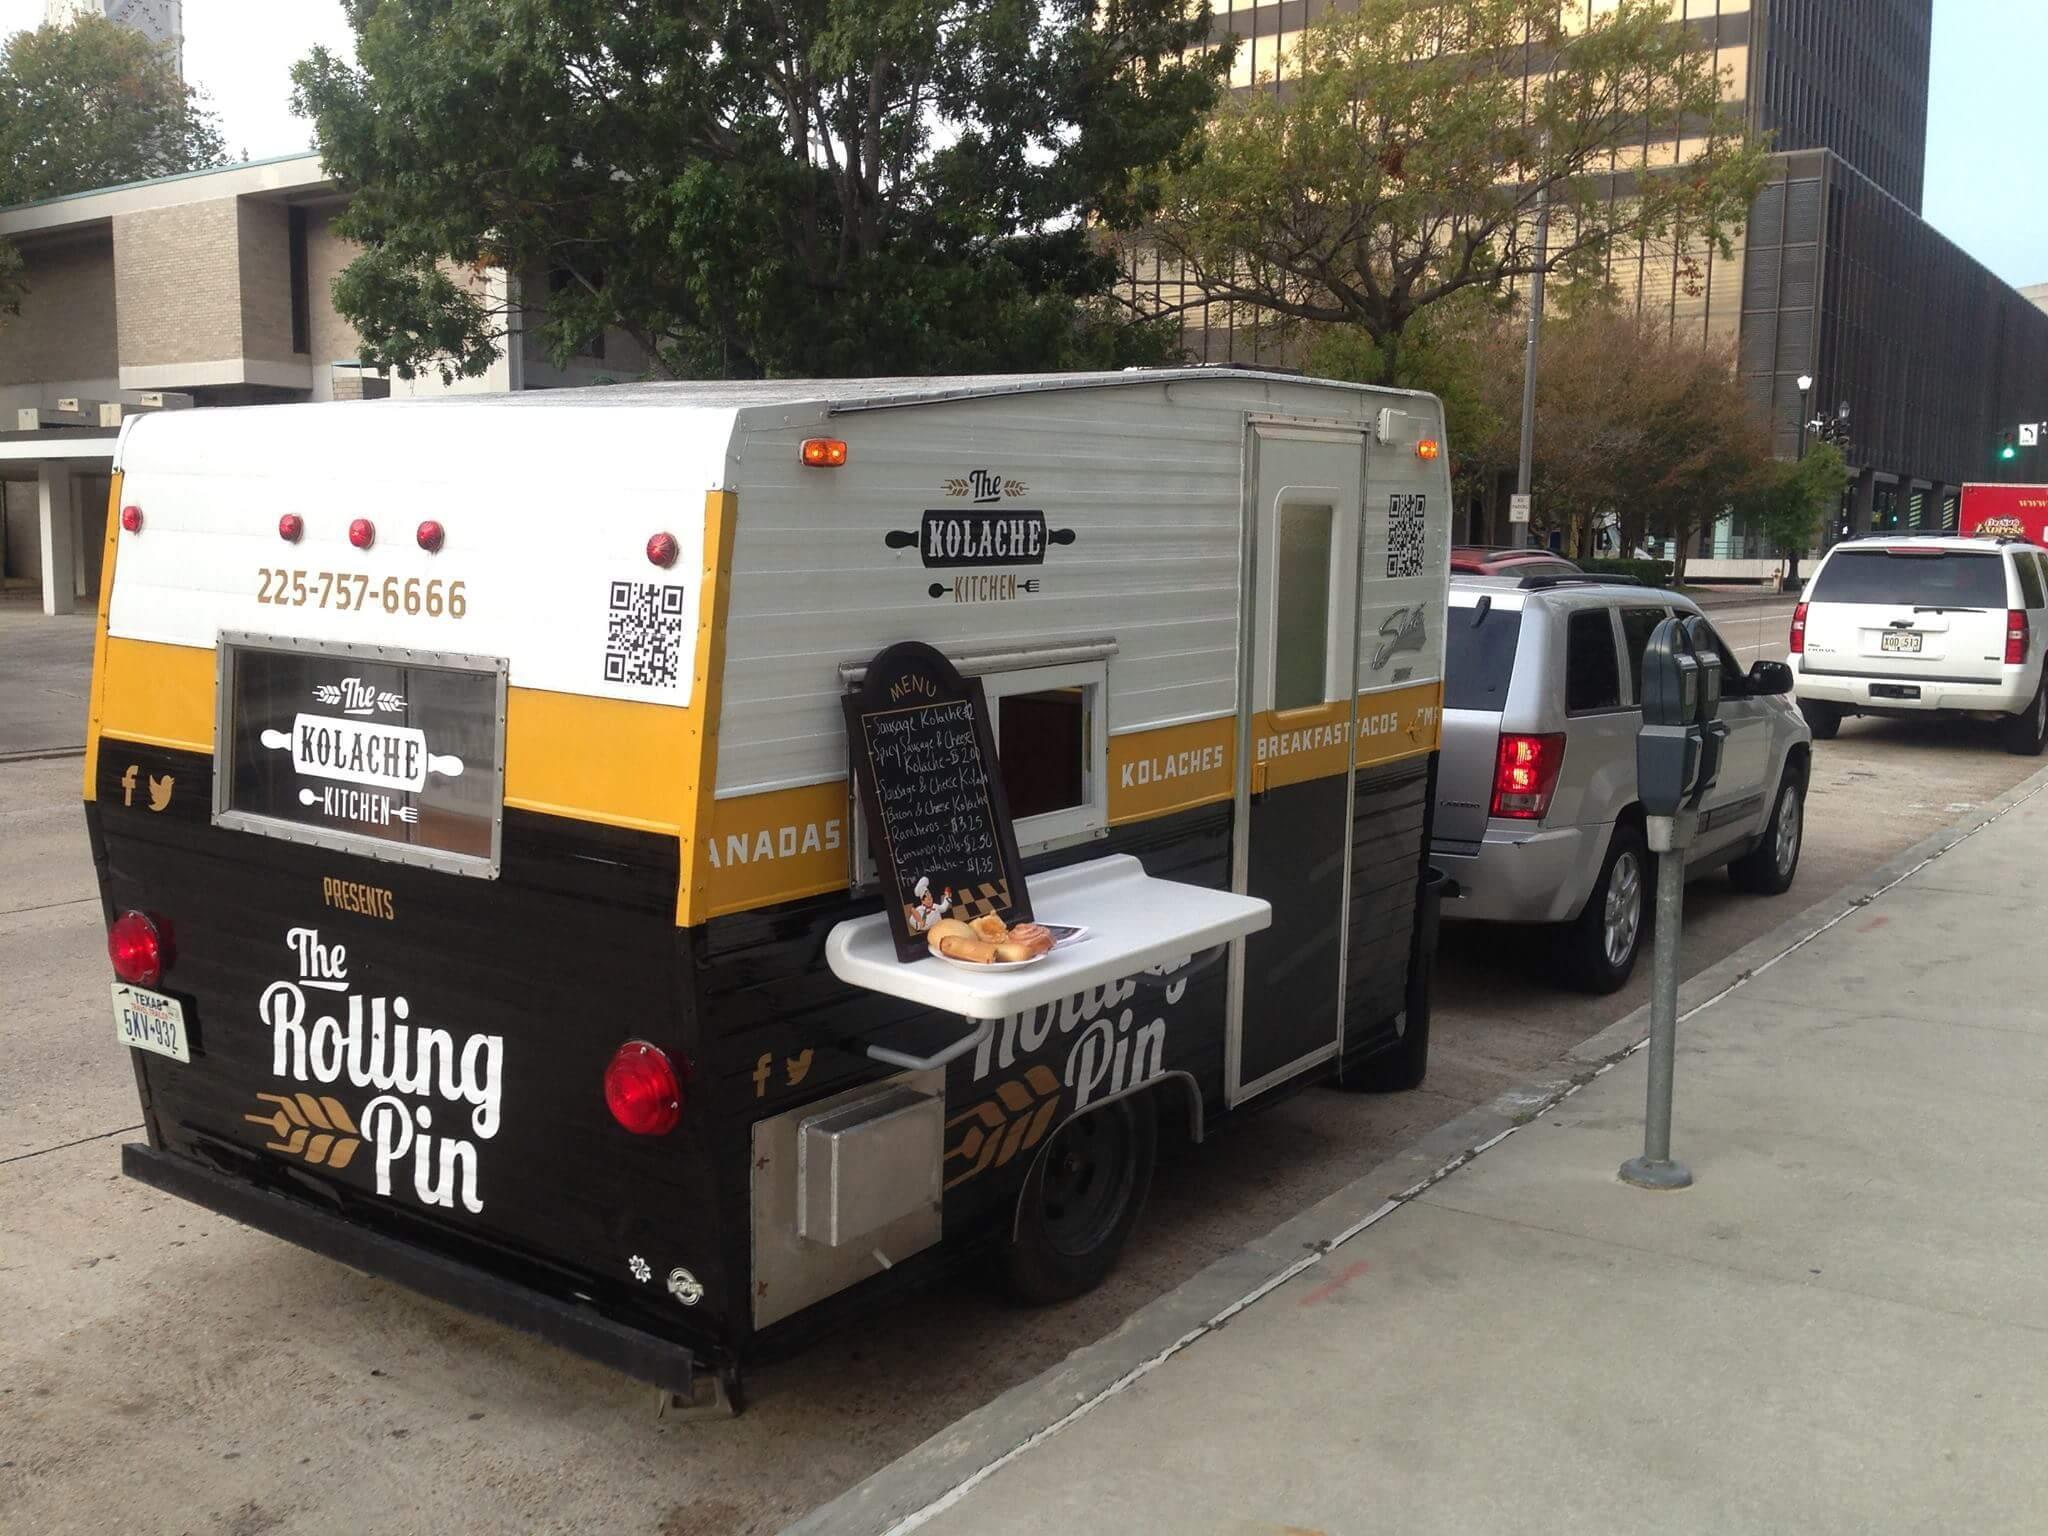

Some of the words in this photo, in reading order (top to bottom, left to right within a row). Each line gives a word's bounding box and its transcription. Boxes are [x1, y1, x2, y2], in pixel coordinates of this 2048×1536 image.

[969, 470, 1002, 503] The
[928, 519, 1041, 558] KOLACHE
[258, 568, 467, 619] 225-757-6666
[954, 575, 1017, 603] KITCHEN
[341, 678, 375, 714] The
[890, 674, 937, 702] MENU
[873, 716, 917, 744] Sausage
[873, 738, 902, 768] Spicy
[900, 736, 934, 759] Sausage
[1257, 722, 1351, 761] BREAKFAST
[1356, 711, 1398, 738] ACOS
[300, 724, 420, 781] KOLACHE
[1121, 745, 1224, 789] KOLACHES
[324, 785, 391, 827] KITCHEN
[323, 876, 394, 921] PRESENTS
[287, 928, 349, 992] The
[259, 980, 503, 1140] Rolling
[1065, 1008, 1166, 1111] Pin
[360, 1095, 484, 1214] Pin
